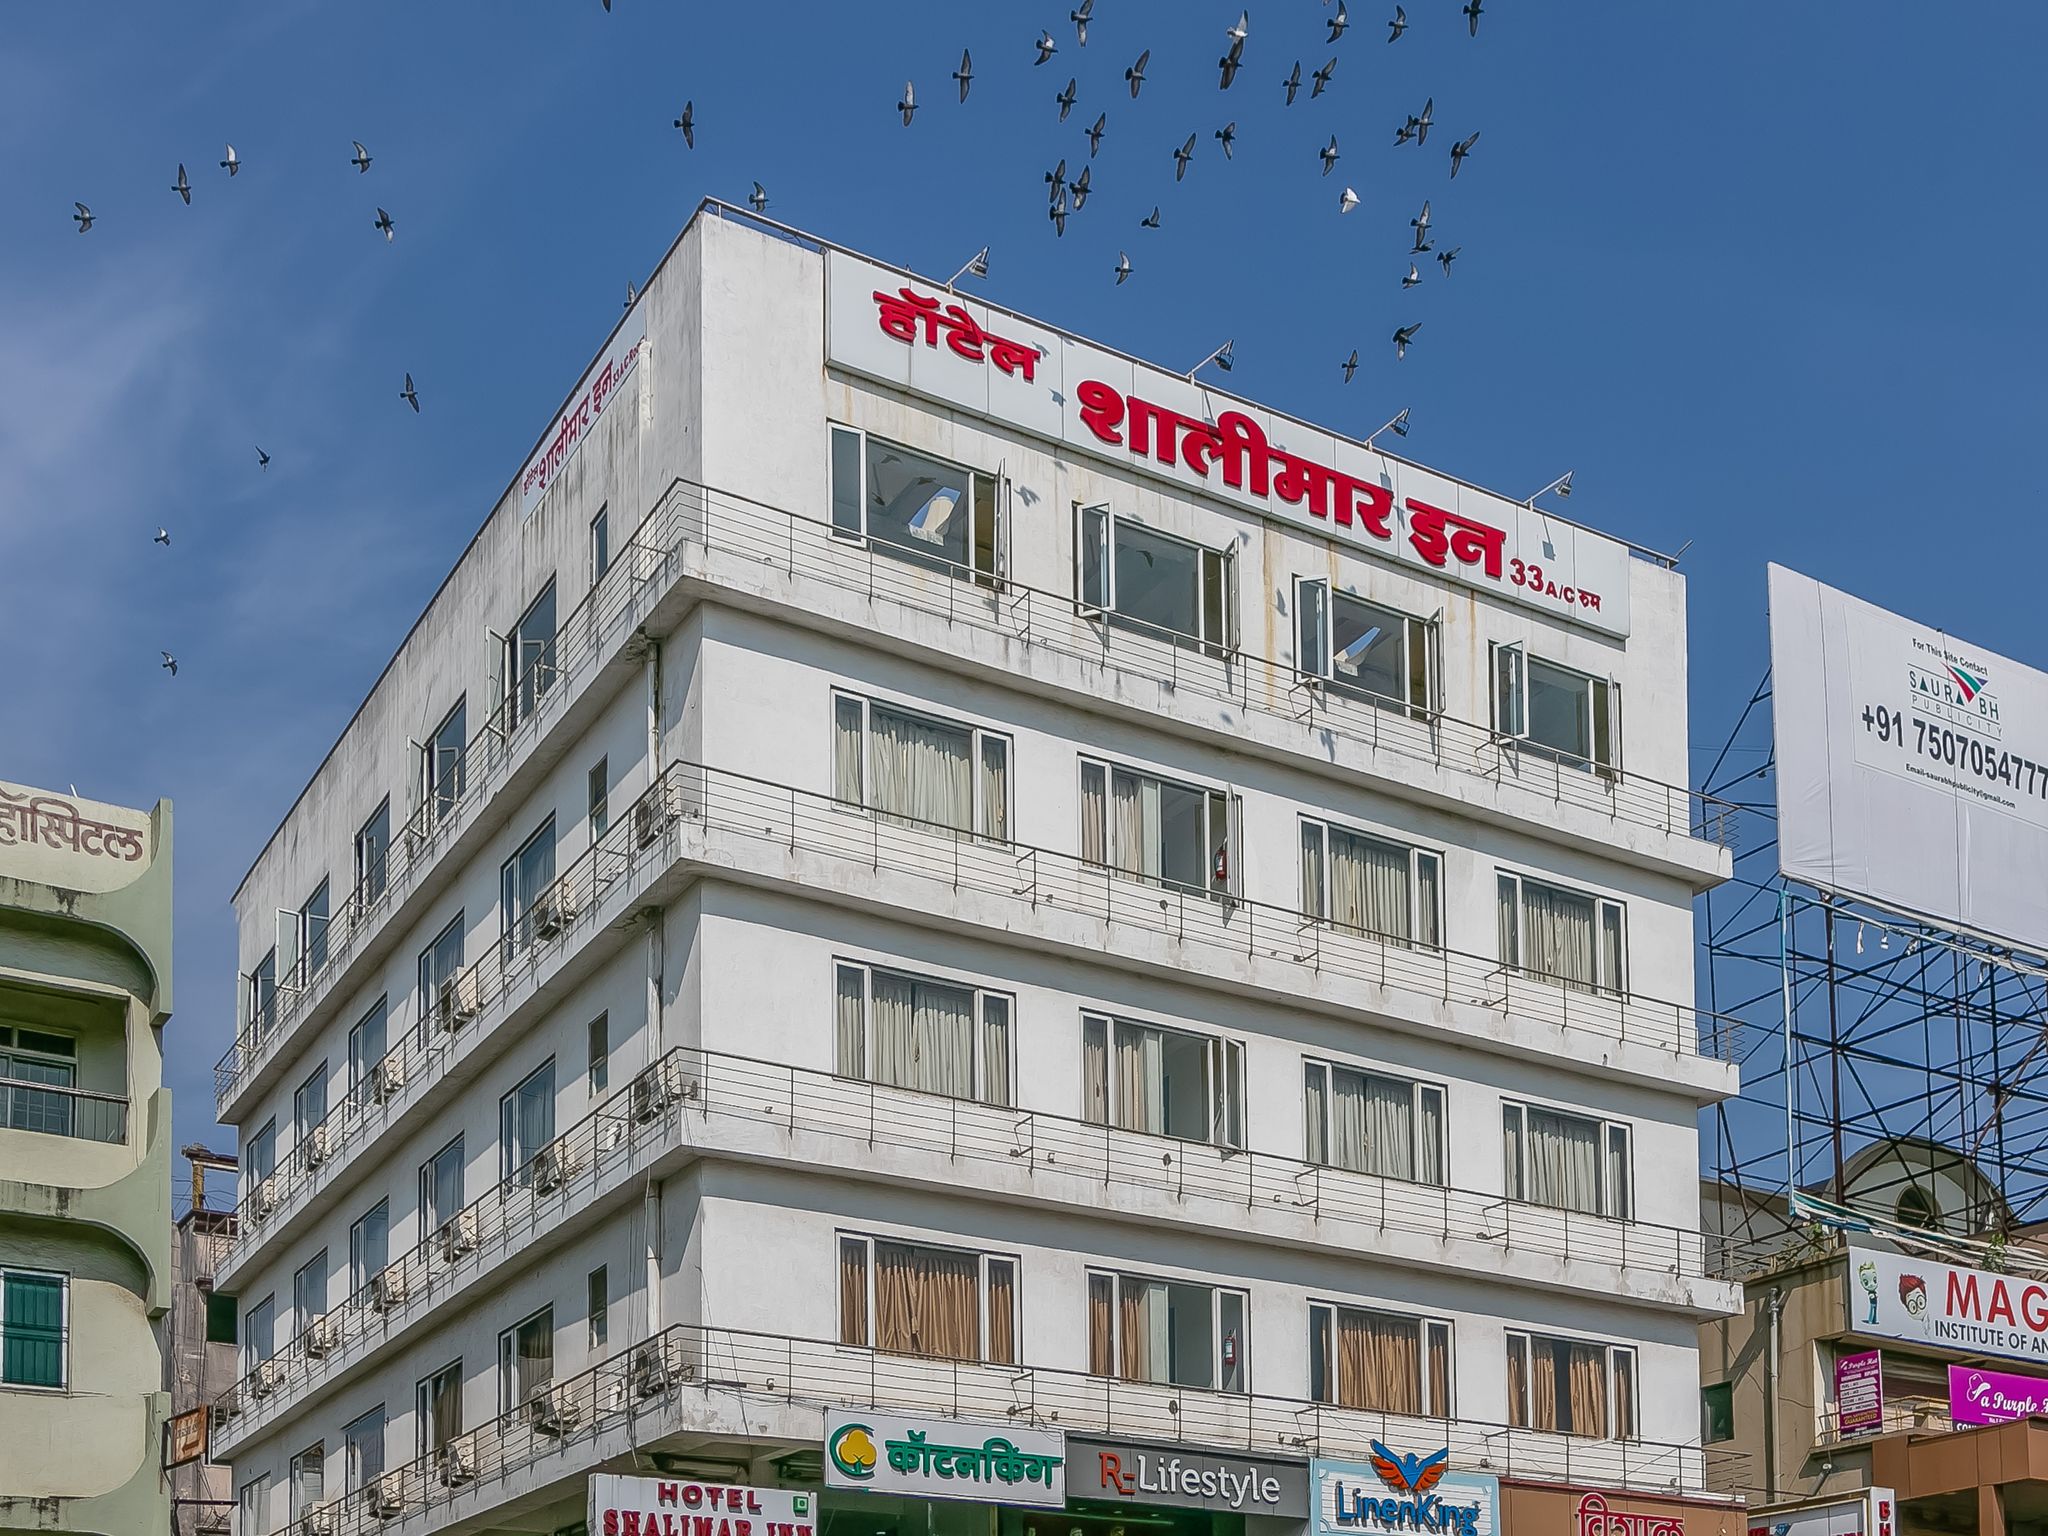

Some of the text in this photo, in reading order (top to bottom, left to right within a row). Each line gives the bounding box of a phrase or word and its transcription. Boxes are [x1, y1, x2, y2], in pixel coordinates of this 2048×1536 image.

[538, 414, 591, 490] शालीमार
[592, 355, 614, 414] इन
[873, 286, 1041, 382] हॉटेल
[1077, 379, 1393, 540] शालीमार
[1404, 496, 1506, 579] इन
[1510, 558, 1544, 592] 33
[1545, 580, 1575, 604] A/C
[1912, 638, 1989, 676] For This Site Contact
[1909, 669, 2000, 720] SAURABH
[1912, 695, 2003, 736] PUBLICITY
[1862, 704, 2048, 800] +91 7507054777
[1946, 1270, 2048, 1333] MAG
[1935, 1320, 2004, 1347] INSTITUTE
[2008, 1333, 2027, 1350] OF
[1981, 1396, 1990, 1408] a
[1992, 1391, 2038, 1418] Purple
[885, 1430, 1064, 1486] कॉटनकिंग
[603, 1509, 753, 1536] SHALIMAR
[658, 1482, 763, 1512] HOTEL
[1336, 1481, 1480, 1536] LinenKing
